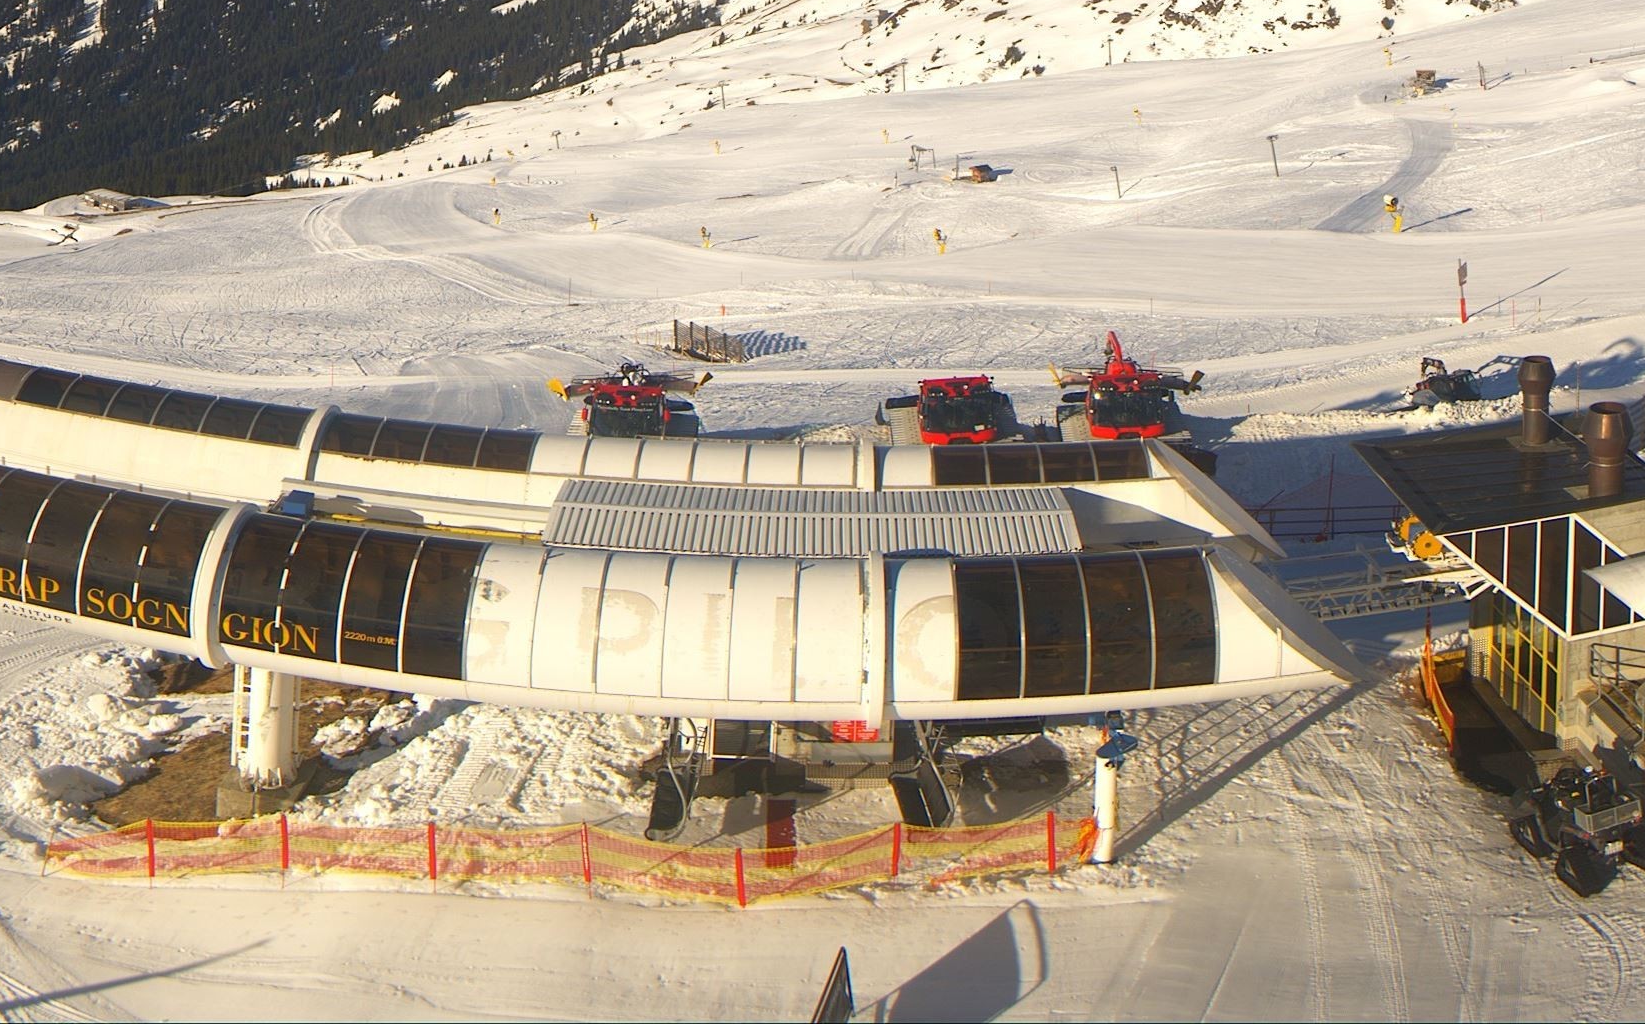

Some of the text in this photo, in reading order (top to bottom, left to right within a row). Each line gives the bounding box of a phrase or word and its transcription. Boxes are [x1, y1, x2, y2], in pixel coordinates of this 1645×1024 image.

[2, 603, 73, 625] ALTITUDE
[86, 588, 189, 631] SOGN
[222, 613, 319, 654] GION
[344, 631, 367, 642] 2220
